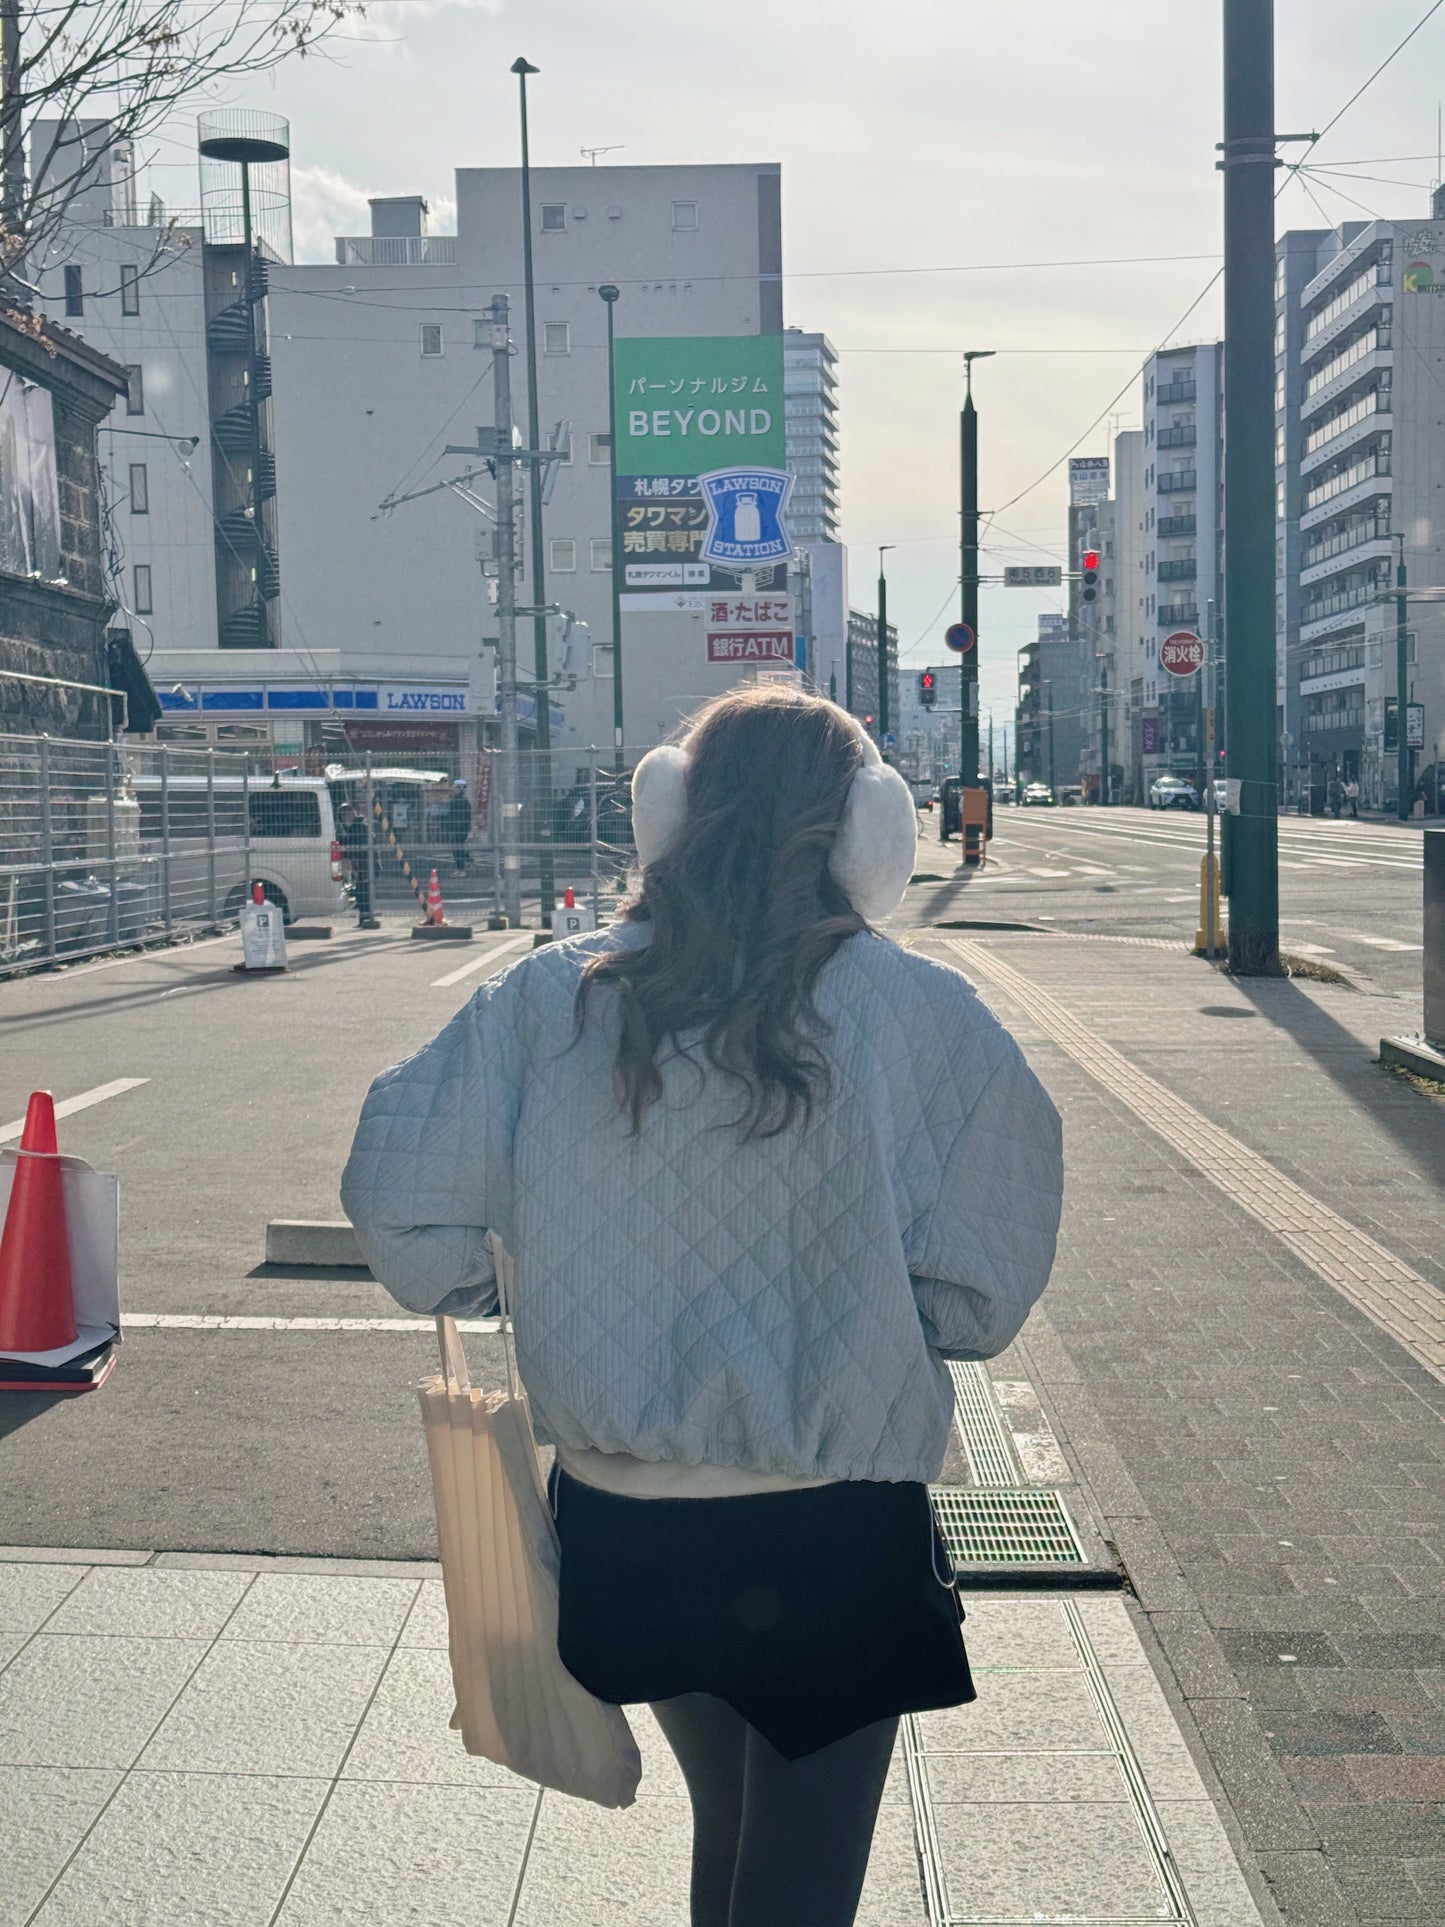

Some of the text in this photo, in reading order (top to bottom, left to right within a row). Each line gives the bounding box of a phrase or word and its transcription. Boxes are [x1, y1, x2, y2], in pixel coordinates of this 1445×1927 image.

[629, 377, 768, 394] パーソナルジム
[629, 409, 771, 436] BEYOND
[710, 477, 784, 496] LAWSON
[713, 539, 783, 557] STATION
[711, 602, 789, 622] 酒・たばこ
[713, 637, 788, 657] 銀行ATM
[1164, 645, 1201, 663] 消火栓
[387, 693, 466, 710] LAWSON
